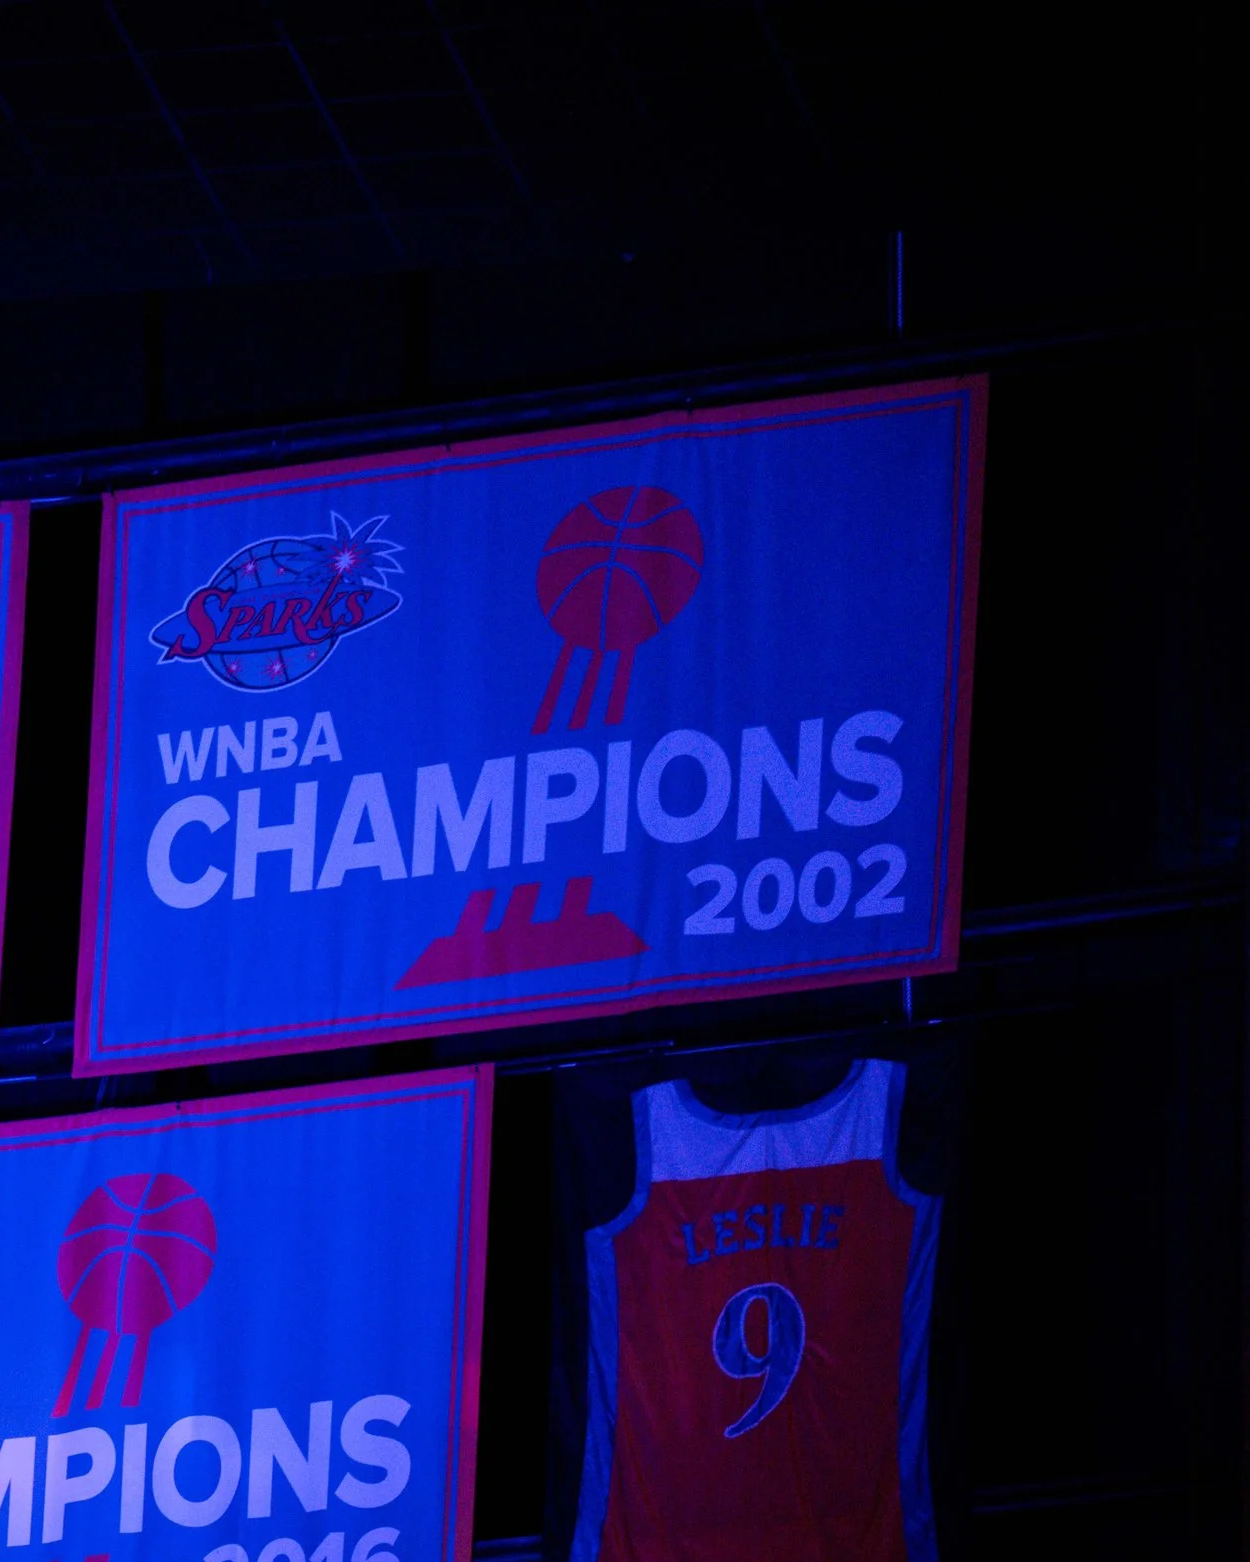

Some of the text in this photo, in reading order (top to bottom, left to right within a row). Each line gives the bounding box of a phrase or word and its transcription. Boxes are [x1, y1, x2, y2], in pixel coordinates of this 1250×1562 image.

[164, 574, 373, 659] SPARKS
[158, 711, 343, 784] WNBA
[146, 710, 905, 910] CHAMPIONS
[683, 844, 908, 936] 2002
[681, 1203, 847, 1267] LESLIE
[711, 1281, 807, 1440] 9
